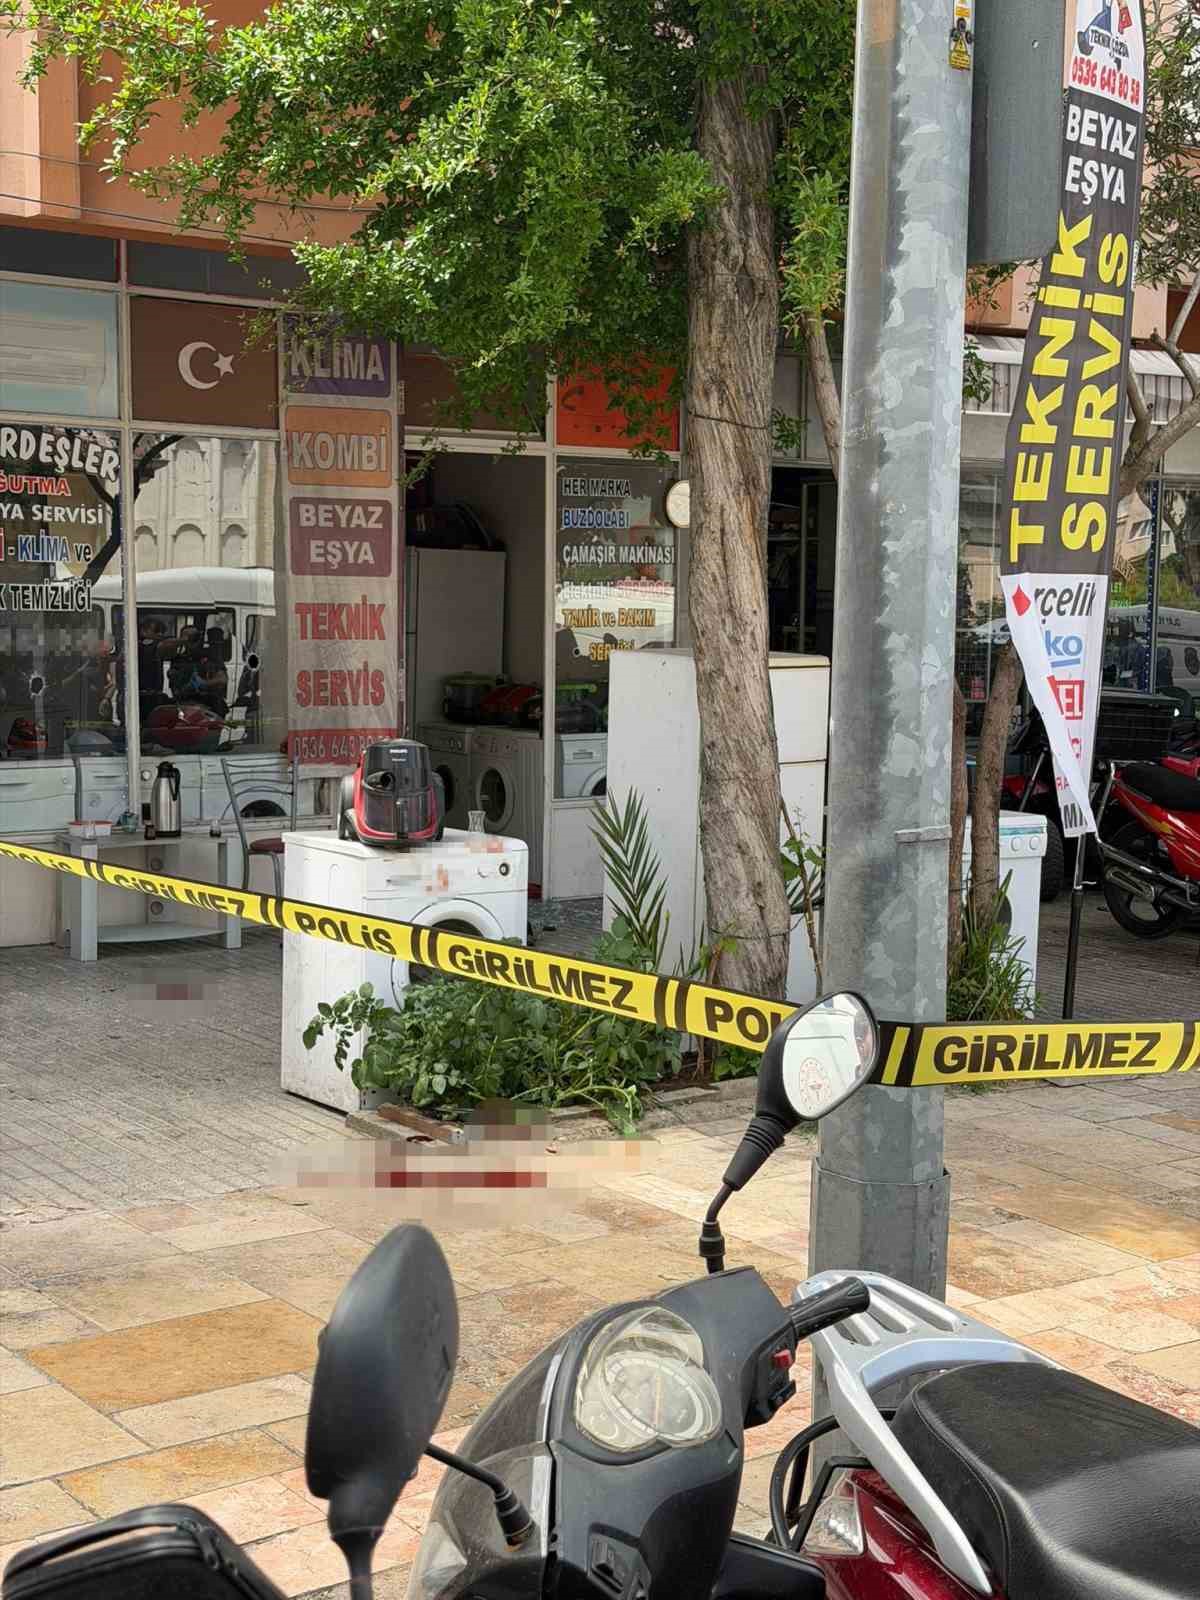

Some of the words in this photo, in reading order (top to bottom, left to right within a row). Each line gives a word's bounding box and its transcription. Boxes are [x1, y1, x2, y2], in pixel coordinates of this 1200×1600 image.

[1072, 56, 1098, 87] 0536
[1100, 65, 1117, 95] 643
[1065, 104, 1137, 160] BEYAZ
[1064, 155, 1126, 205] EŞYA
[1008, 210, 1094, 564] TEKNİK
[1060, 232, 1129, 553] SERVİS
[291, 428, 388, 473] KOMBİ
[562, 478, 588, 497] HER
[589, 479, 631, 498] MARKA
[31, 504, 104, 525] SERVİSİ
[299, 503, 384, 529] BEYAZ
[561, 509, 631, 529] BUZDOLABI
[17, 529, 71, 563] KLİMA
[74, 542, 92, 563] ve
[309, 540, 375, 569] EŞYA
[562, 545, 617, 568] ÇAMAŞIR
[618, 542, 675, 565] MAKİNASI
[10, 578, 93, 612] TEMİZLİĞİ
[294, 594, 386, 641] TEKNİK
[561, 604, 600, 628] TAMİR
[602, 612, 616, 627] ve
[618, 608, 656, 628] BAKIM
[295, 661, 386, 708] SERVİS
[294, 736, 326, 758] 0536
